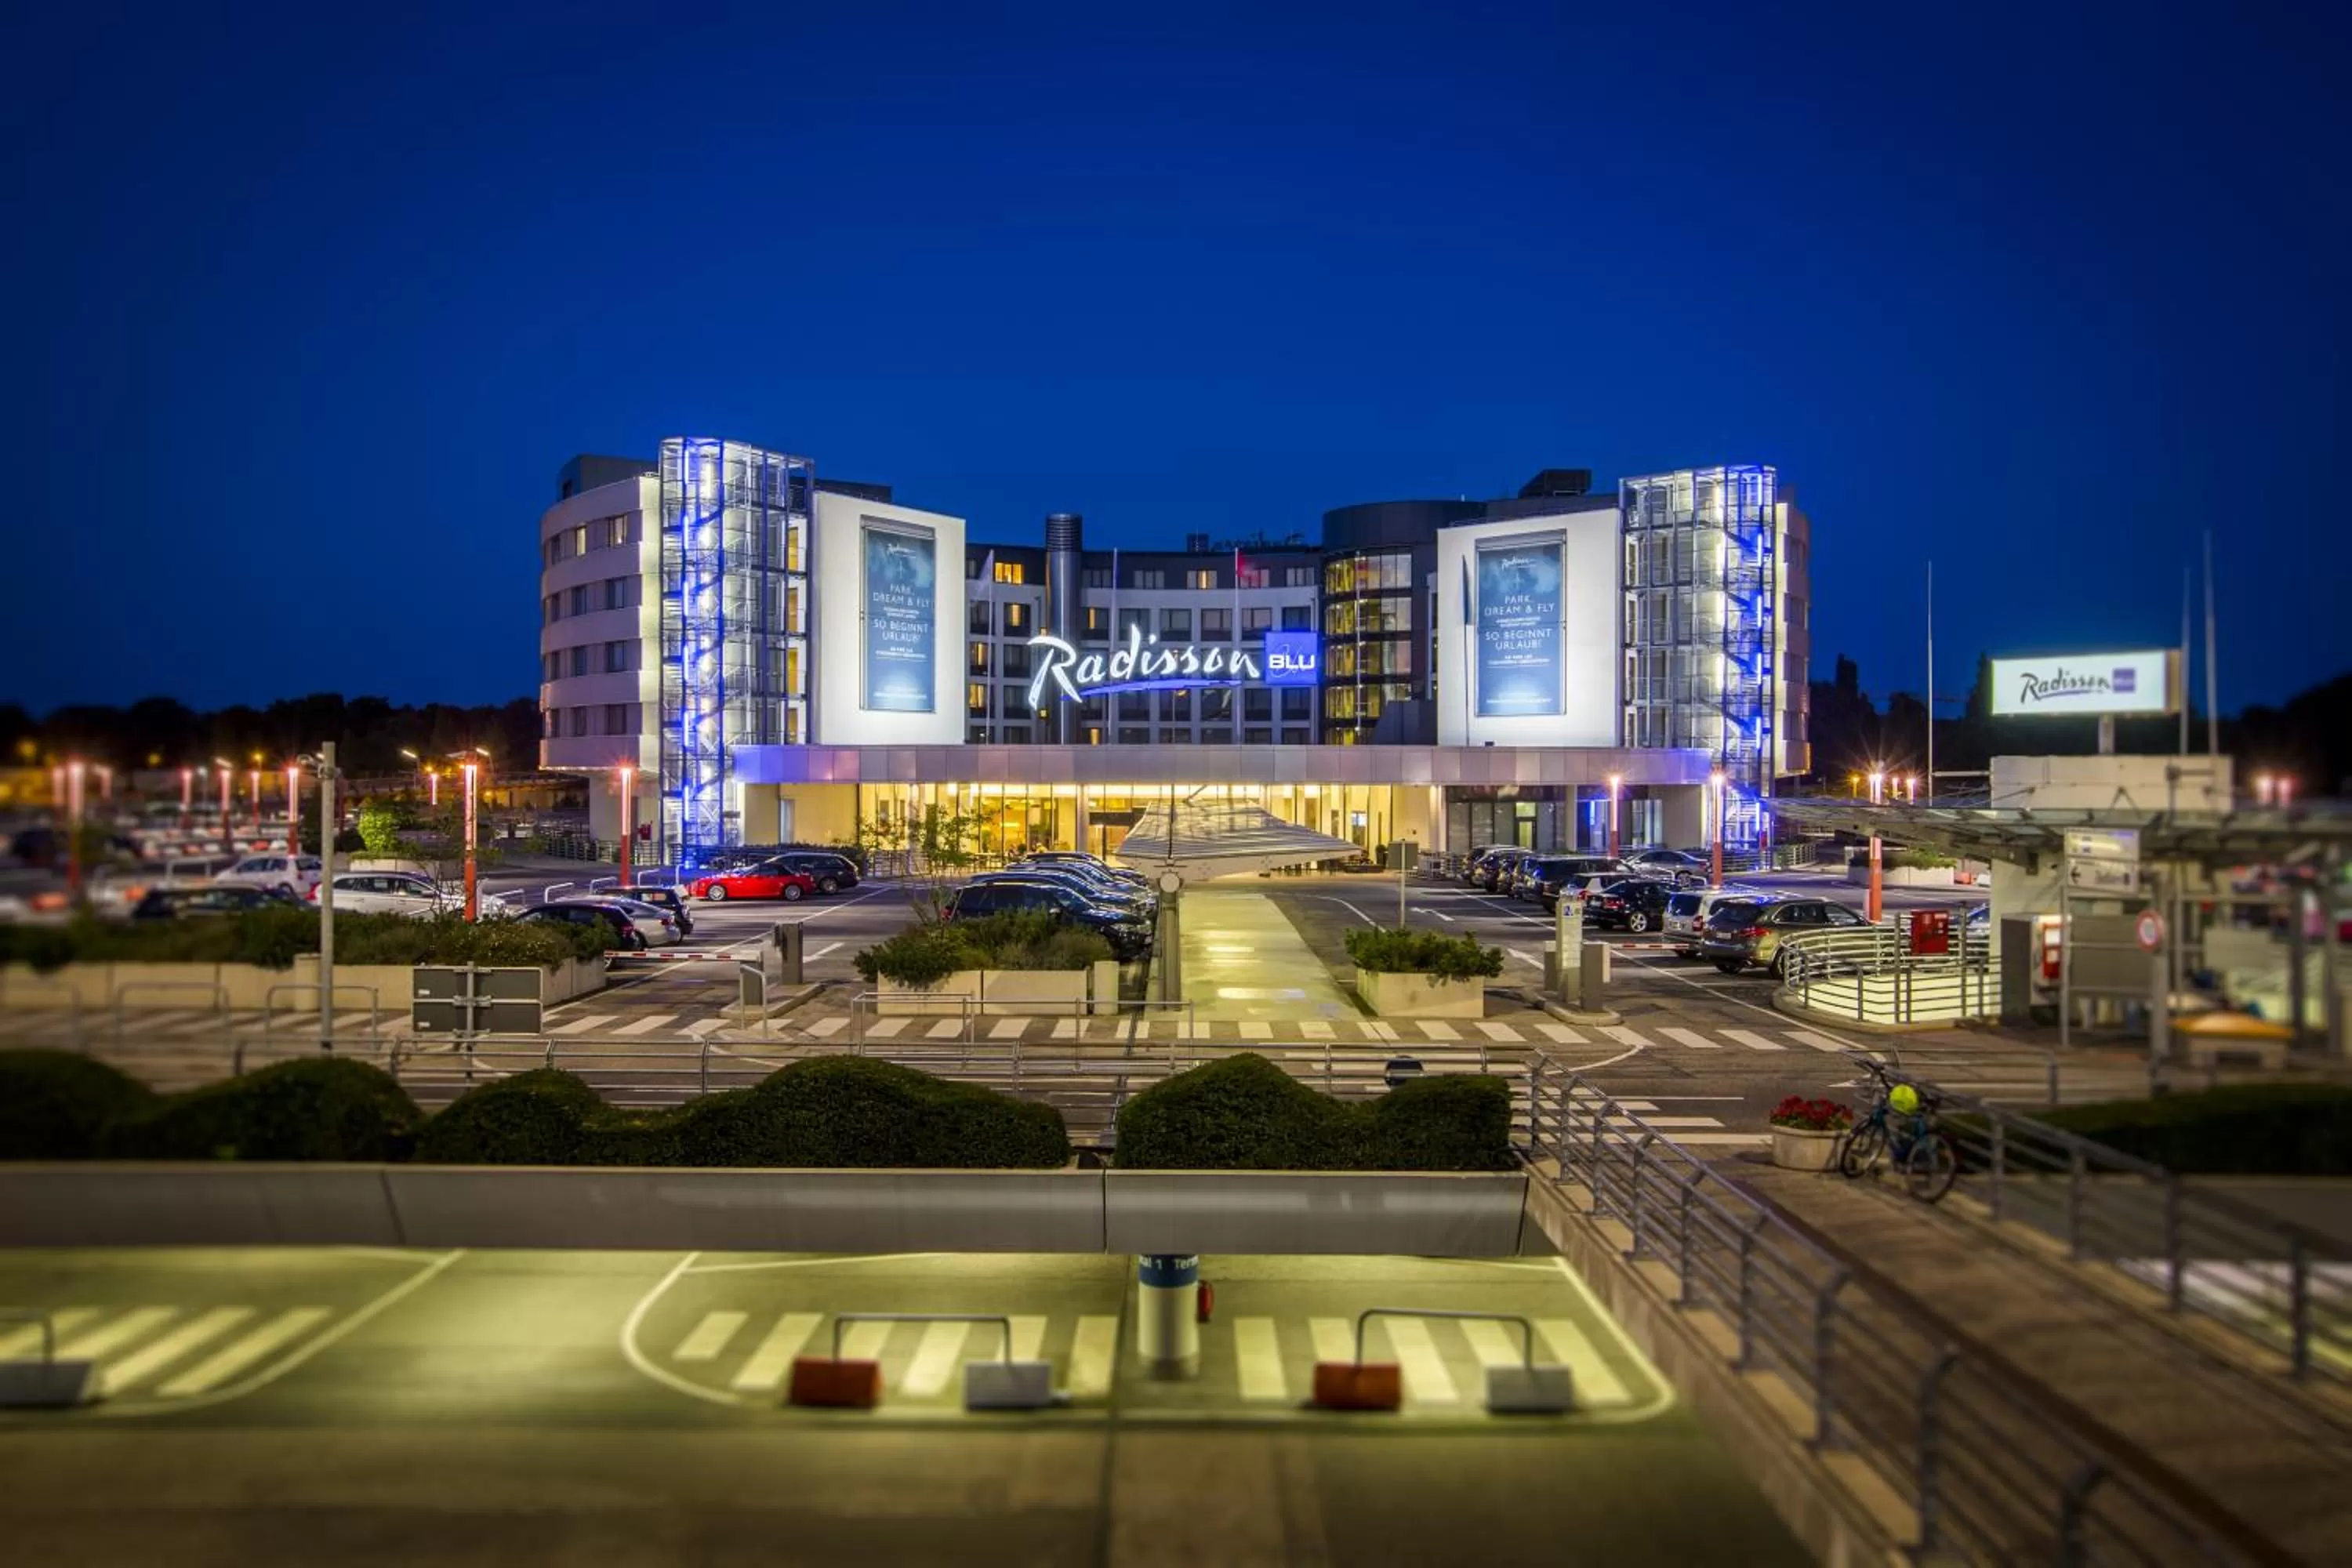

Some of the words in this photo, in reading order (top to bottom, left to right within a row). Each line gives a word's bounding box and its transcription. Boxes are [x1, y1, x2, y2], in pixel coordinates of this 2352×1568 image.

[873, 590, 904, 604] DREAM
[1484, 605, 1520, 615] DREAM
[1526, 604, 1533, 613] &
[1537, 603, 1555, 612] FLY
[872, 618, 887, 629] SO
[1485, 630, 1500, 641] SO
[1504, 628, 1552, 639] BEGINNT
[1026, 623, 1261, 710] Radisson
[1269, 654, 1315, 670] BLU
[2020, 666, 2111, 704] Radisson
[1156, 1258, 1163, 1269] 1
